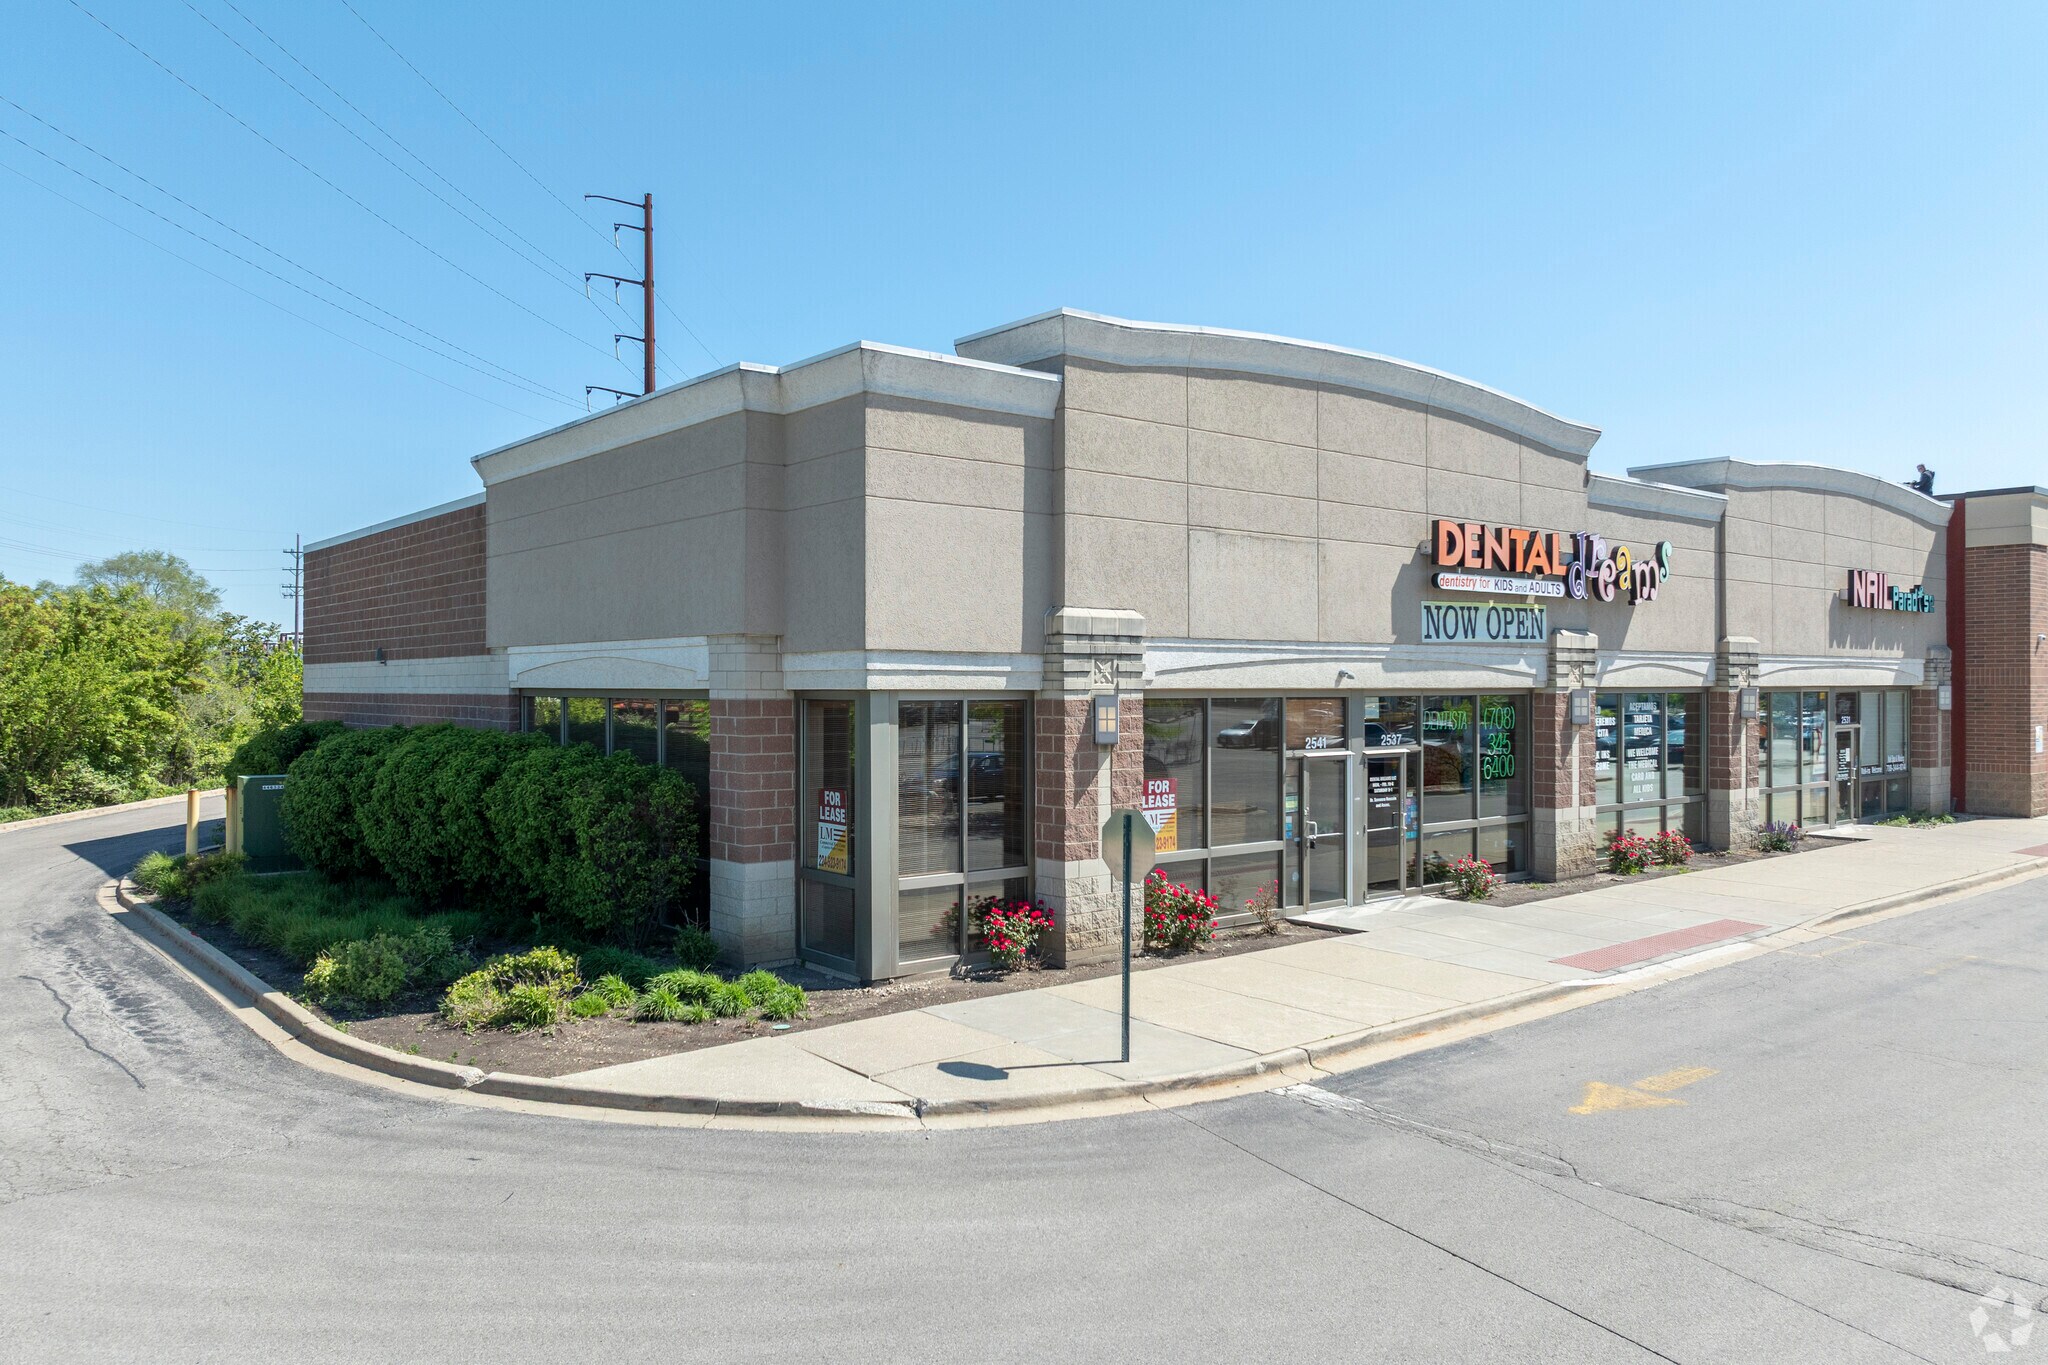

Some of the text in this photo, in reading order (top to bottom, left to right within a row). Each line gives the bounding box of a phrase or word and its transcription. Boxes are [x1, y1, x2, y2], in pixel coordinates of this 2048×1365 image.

[1432, 519, 1673, 605] DENTAL dreams
[1440, 575, 1561, 595] dentistry for KIDS and ADULTS
[1848, 569, 1893, 610] NAIL
[1424, 605, 1544, 640] NOW OPEN
[1423, 711, 1468, 731] DENTISTA
[1483, 706, 1516, 730] (708)
[1305, 737, 1327, 749] 2541
[1381, 734, 1402, 746] 2537
[1488, 733, 1511, 755] 345
[1484, 754, 1515, 779] 6400
[1148, 780, 1170, 794] FOR
[824, 791, 841, 806] FOR
[1142, 794, 1175, 808] LEASE
[820, 806, 845, 823] LEASE
[820, 826, 833, 841] LM
[1156, 836, 1176, 850] 23-9174
